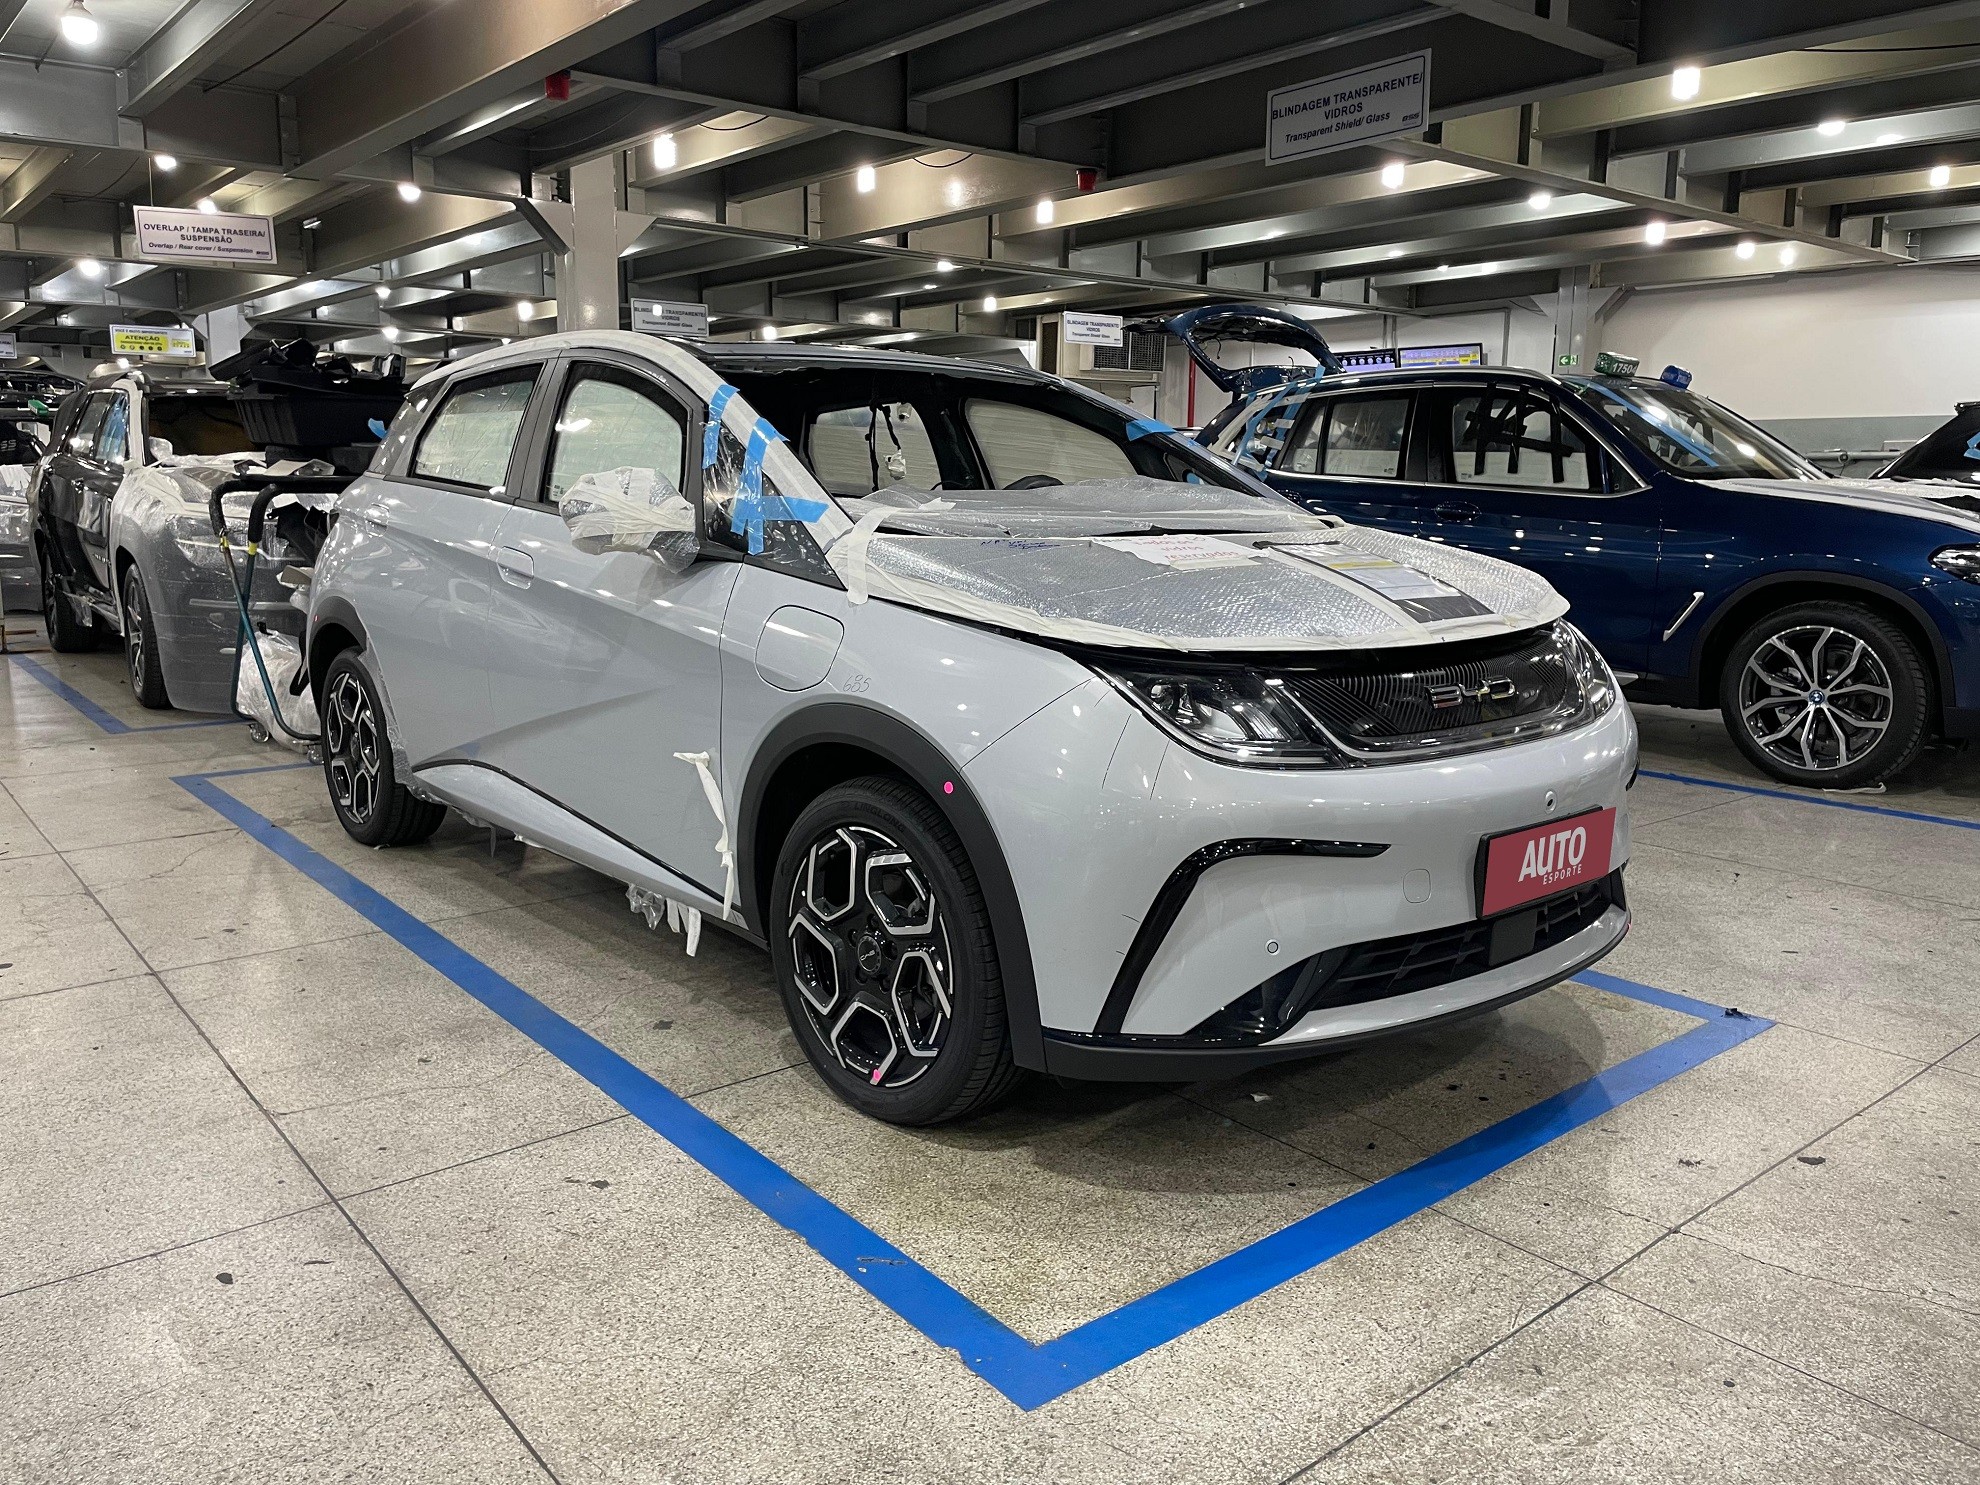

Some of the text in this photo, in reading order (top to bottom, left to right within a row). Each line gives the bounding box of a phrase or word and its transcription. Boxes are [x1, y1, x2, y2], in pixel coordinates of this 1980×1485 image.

[1272, 72, 1423, 120] BLINDAGEM TRANSPARENTE/
[1324, 102, 1363, 120] VIDROS
[1285, 126, 1333, 144] Transparent
[1365, 112, 1390, 125] Glass
[143, 223, 185, 232] OVERLAP
[191, 226, 220, 235] TAMPA
[221, 228, 266, 237] TRASEIRA/
[180, 233, 233, 244] SUSPENSÃO
[148, 242, 174, 250] Overlap
[1425, 678, 1516, 709] BYD
